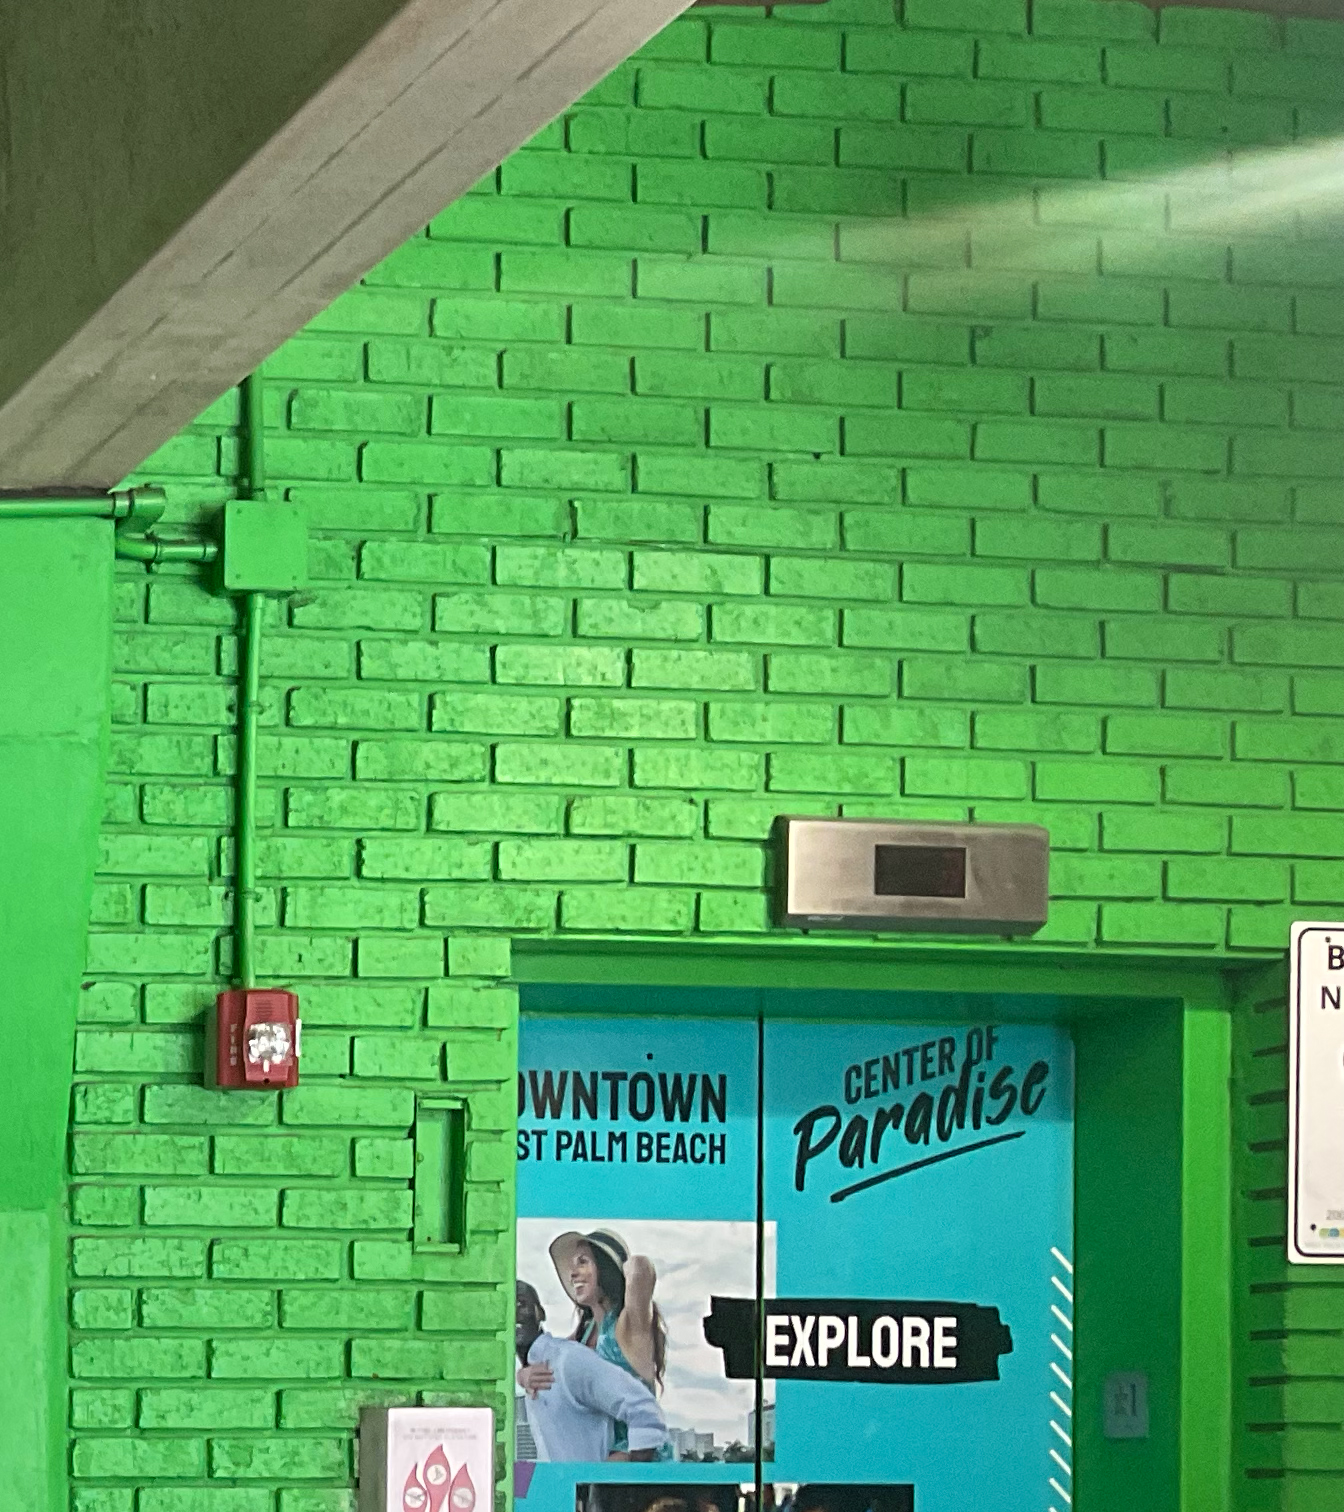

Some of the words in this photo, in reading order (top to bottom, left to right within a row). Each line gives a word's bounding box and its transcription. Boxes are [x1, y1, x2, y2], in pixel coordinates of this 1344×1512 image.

[844, 1035, 956, 1106] CENTER
[965, 1025, 1000, 1067] OF
[555, 1130, 628, 1163] PALM
[635, 1131, 727, 1165] BEACH
[792, 1058, 1050, 1193] Paradise
[765, 1315, 958, 1368] EXPLORE
